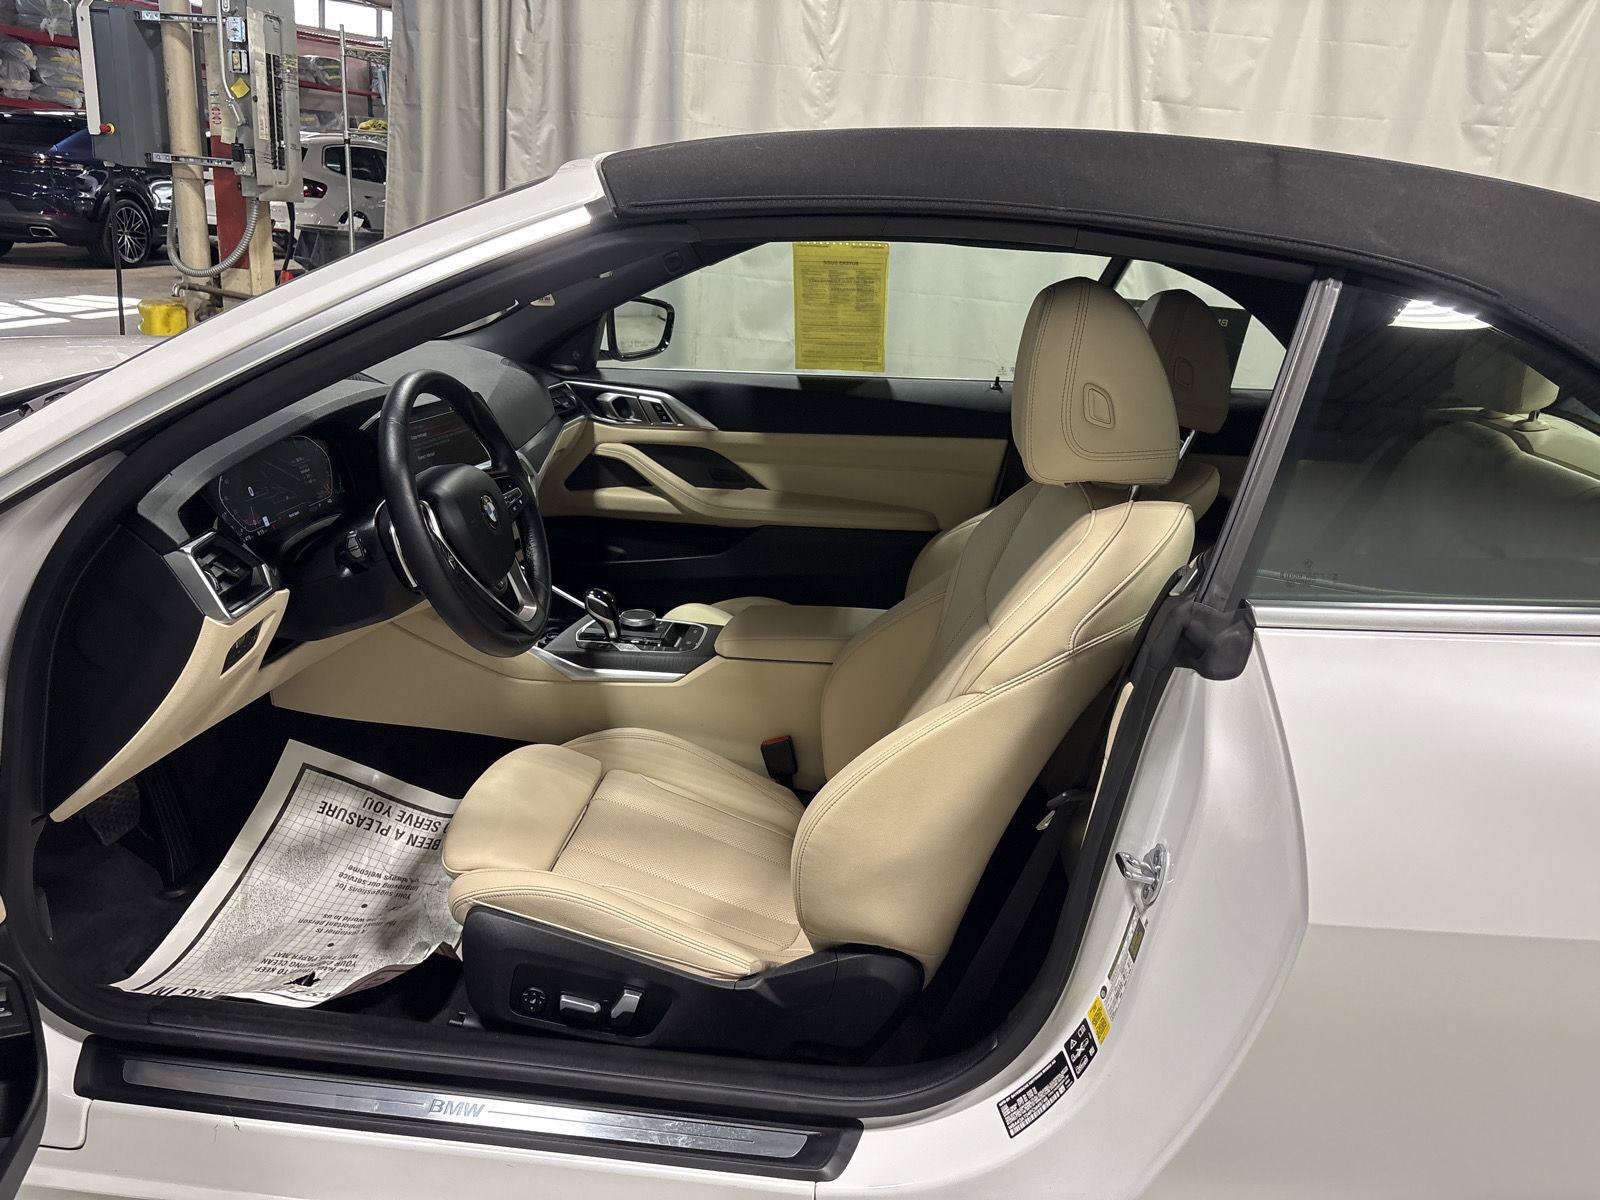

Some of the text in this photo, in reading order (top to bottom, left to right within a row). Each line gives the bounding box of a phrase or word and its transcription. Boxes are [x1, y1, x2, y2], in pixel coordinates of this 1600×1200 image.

[362, 796, 392, 818] YOU
[316, 800, 442, 851] BEEN A PLEASURE
[395, 810, 442, 833] SERVE
[338, 872, 366, 886] service
[384, 874, 408, 884] always
[335, 882, 411, 900] Your suggestions for
[298, 918, 325, 926] person
[325, 920, 362, 930] important
[260, 958, 288, 968] CLEAN
[292, 954, 319, 962] PAPER
[254, 966, 276, 974] KEEP
[429, 1098, 485, 1118] BMW
